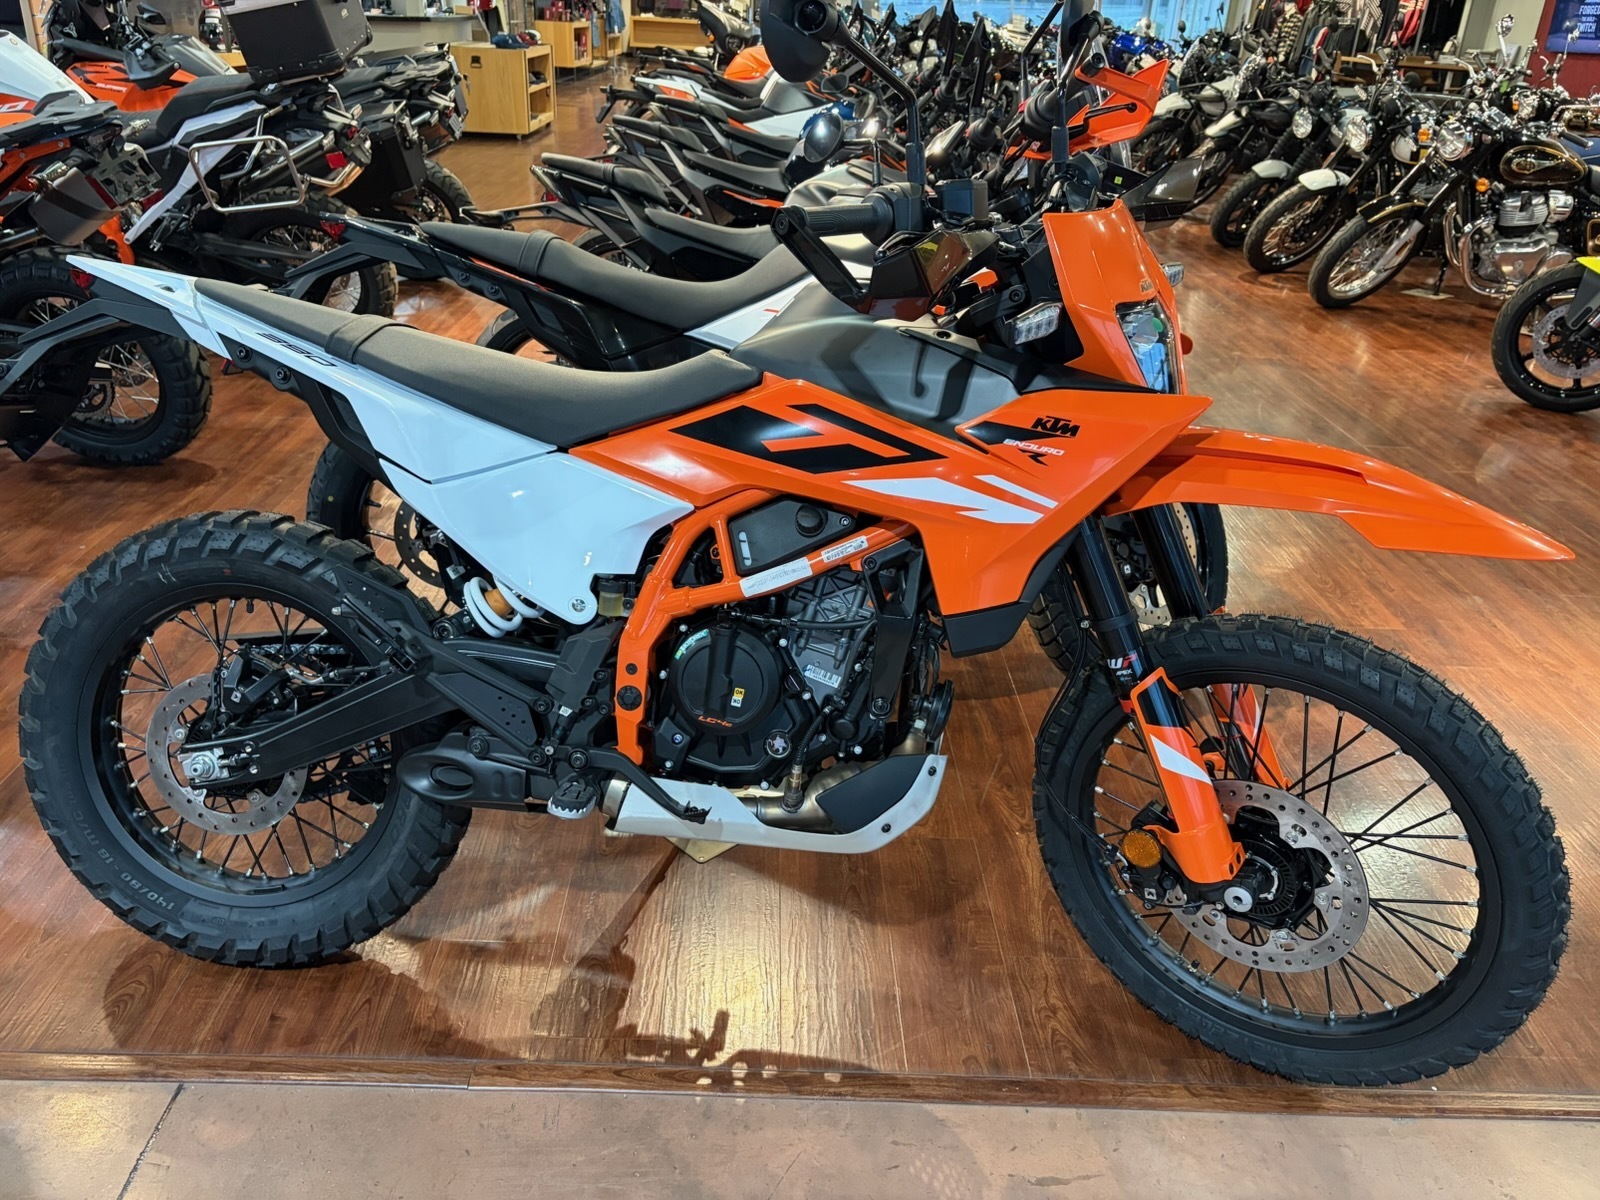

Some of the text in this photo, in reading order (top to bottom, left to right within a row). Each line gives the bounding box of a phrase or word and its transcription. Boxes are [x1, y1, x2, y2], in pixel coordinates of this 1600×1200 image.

[1030, 415, 1081, 437] KTM
[1002, 438, 1065, 456] ENDURO
[1107, 654, 1138, 669] WP
[120, 871, 175, 911] 140/80
